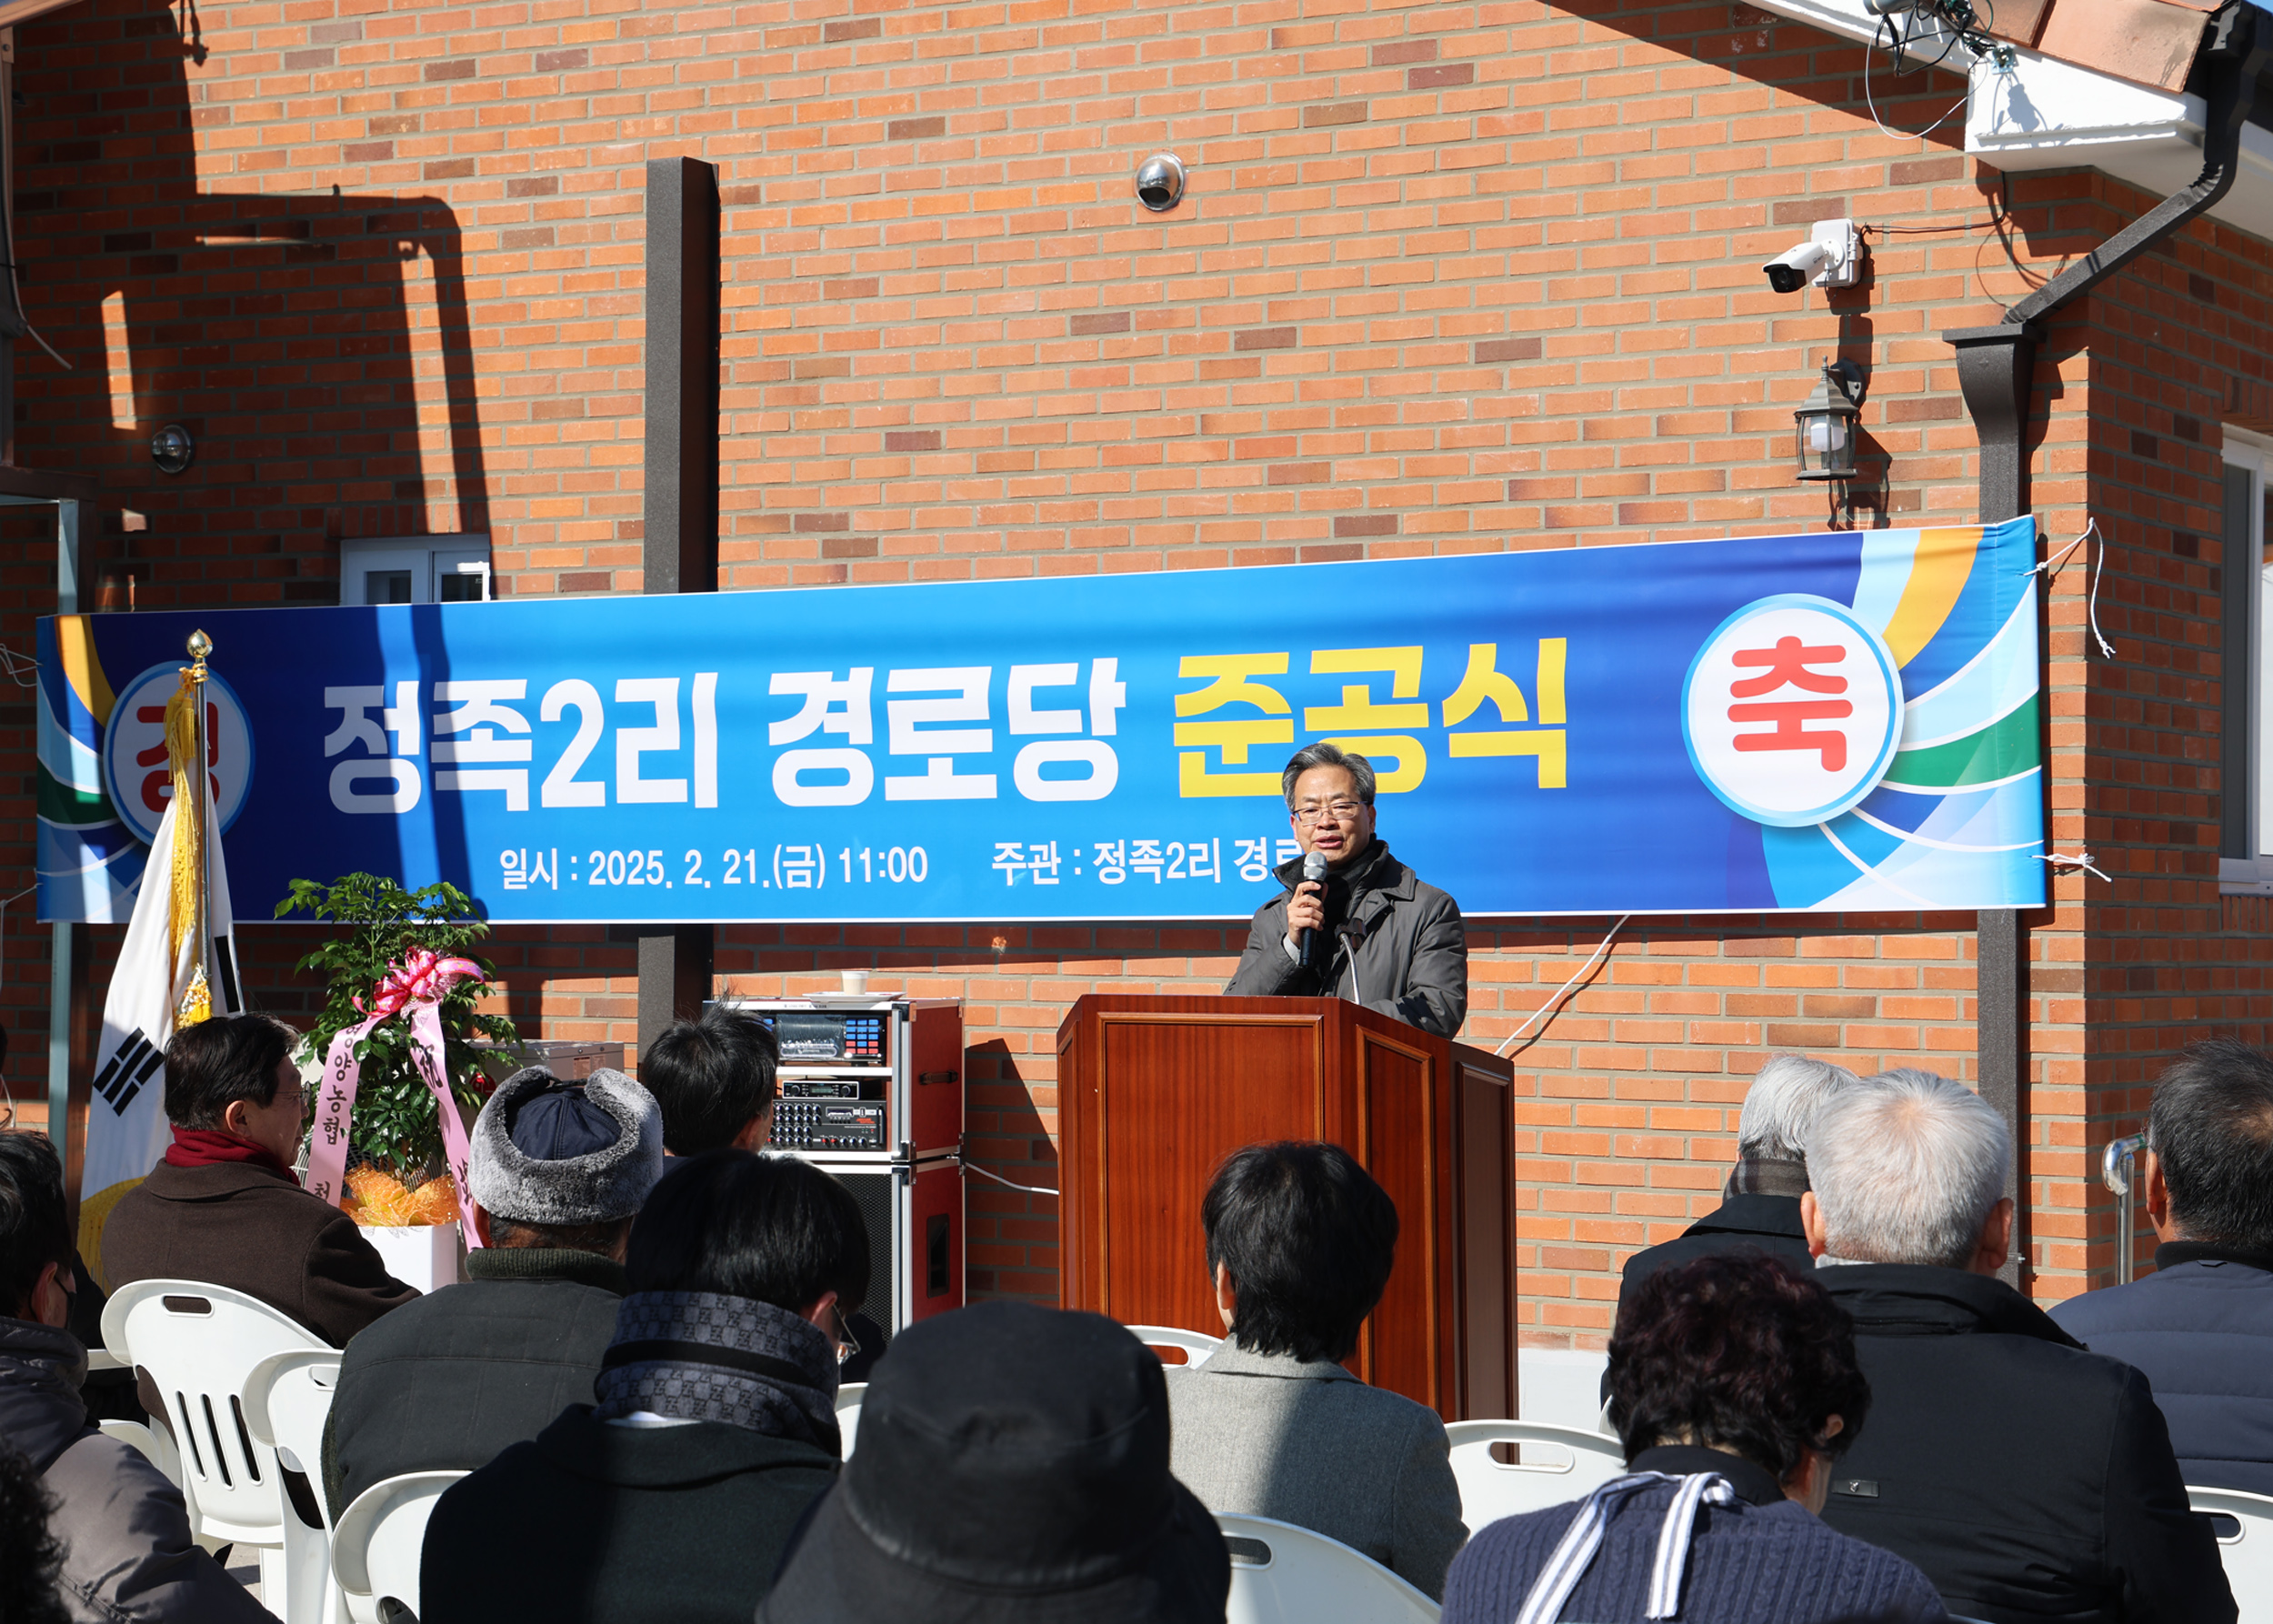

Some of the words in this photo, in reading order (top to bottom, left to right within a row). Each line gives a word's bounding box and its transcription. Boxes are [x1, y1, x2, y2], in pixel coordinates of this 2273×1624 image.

[325, 672, 718, 813] 정족2리
[768, 657, 1126, 807] 경로당
[1174, 637, 1567, 798] 준공식
[1727, 636, 1853, 772] 축
[500, 848, 558, 890] 일시
[589, 850, 673, 888] 2025.
[685, 849, 711, 888] 2.
[838, 847, 928, 883] 11:00
[992, 840, 1062, 887] 주관
[1093, 837, 1221, 884] 정족2리
[323, 1024, 364, 1146] 영양농협
